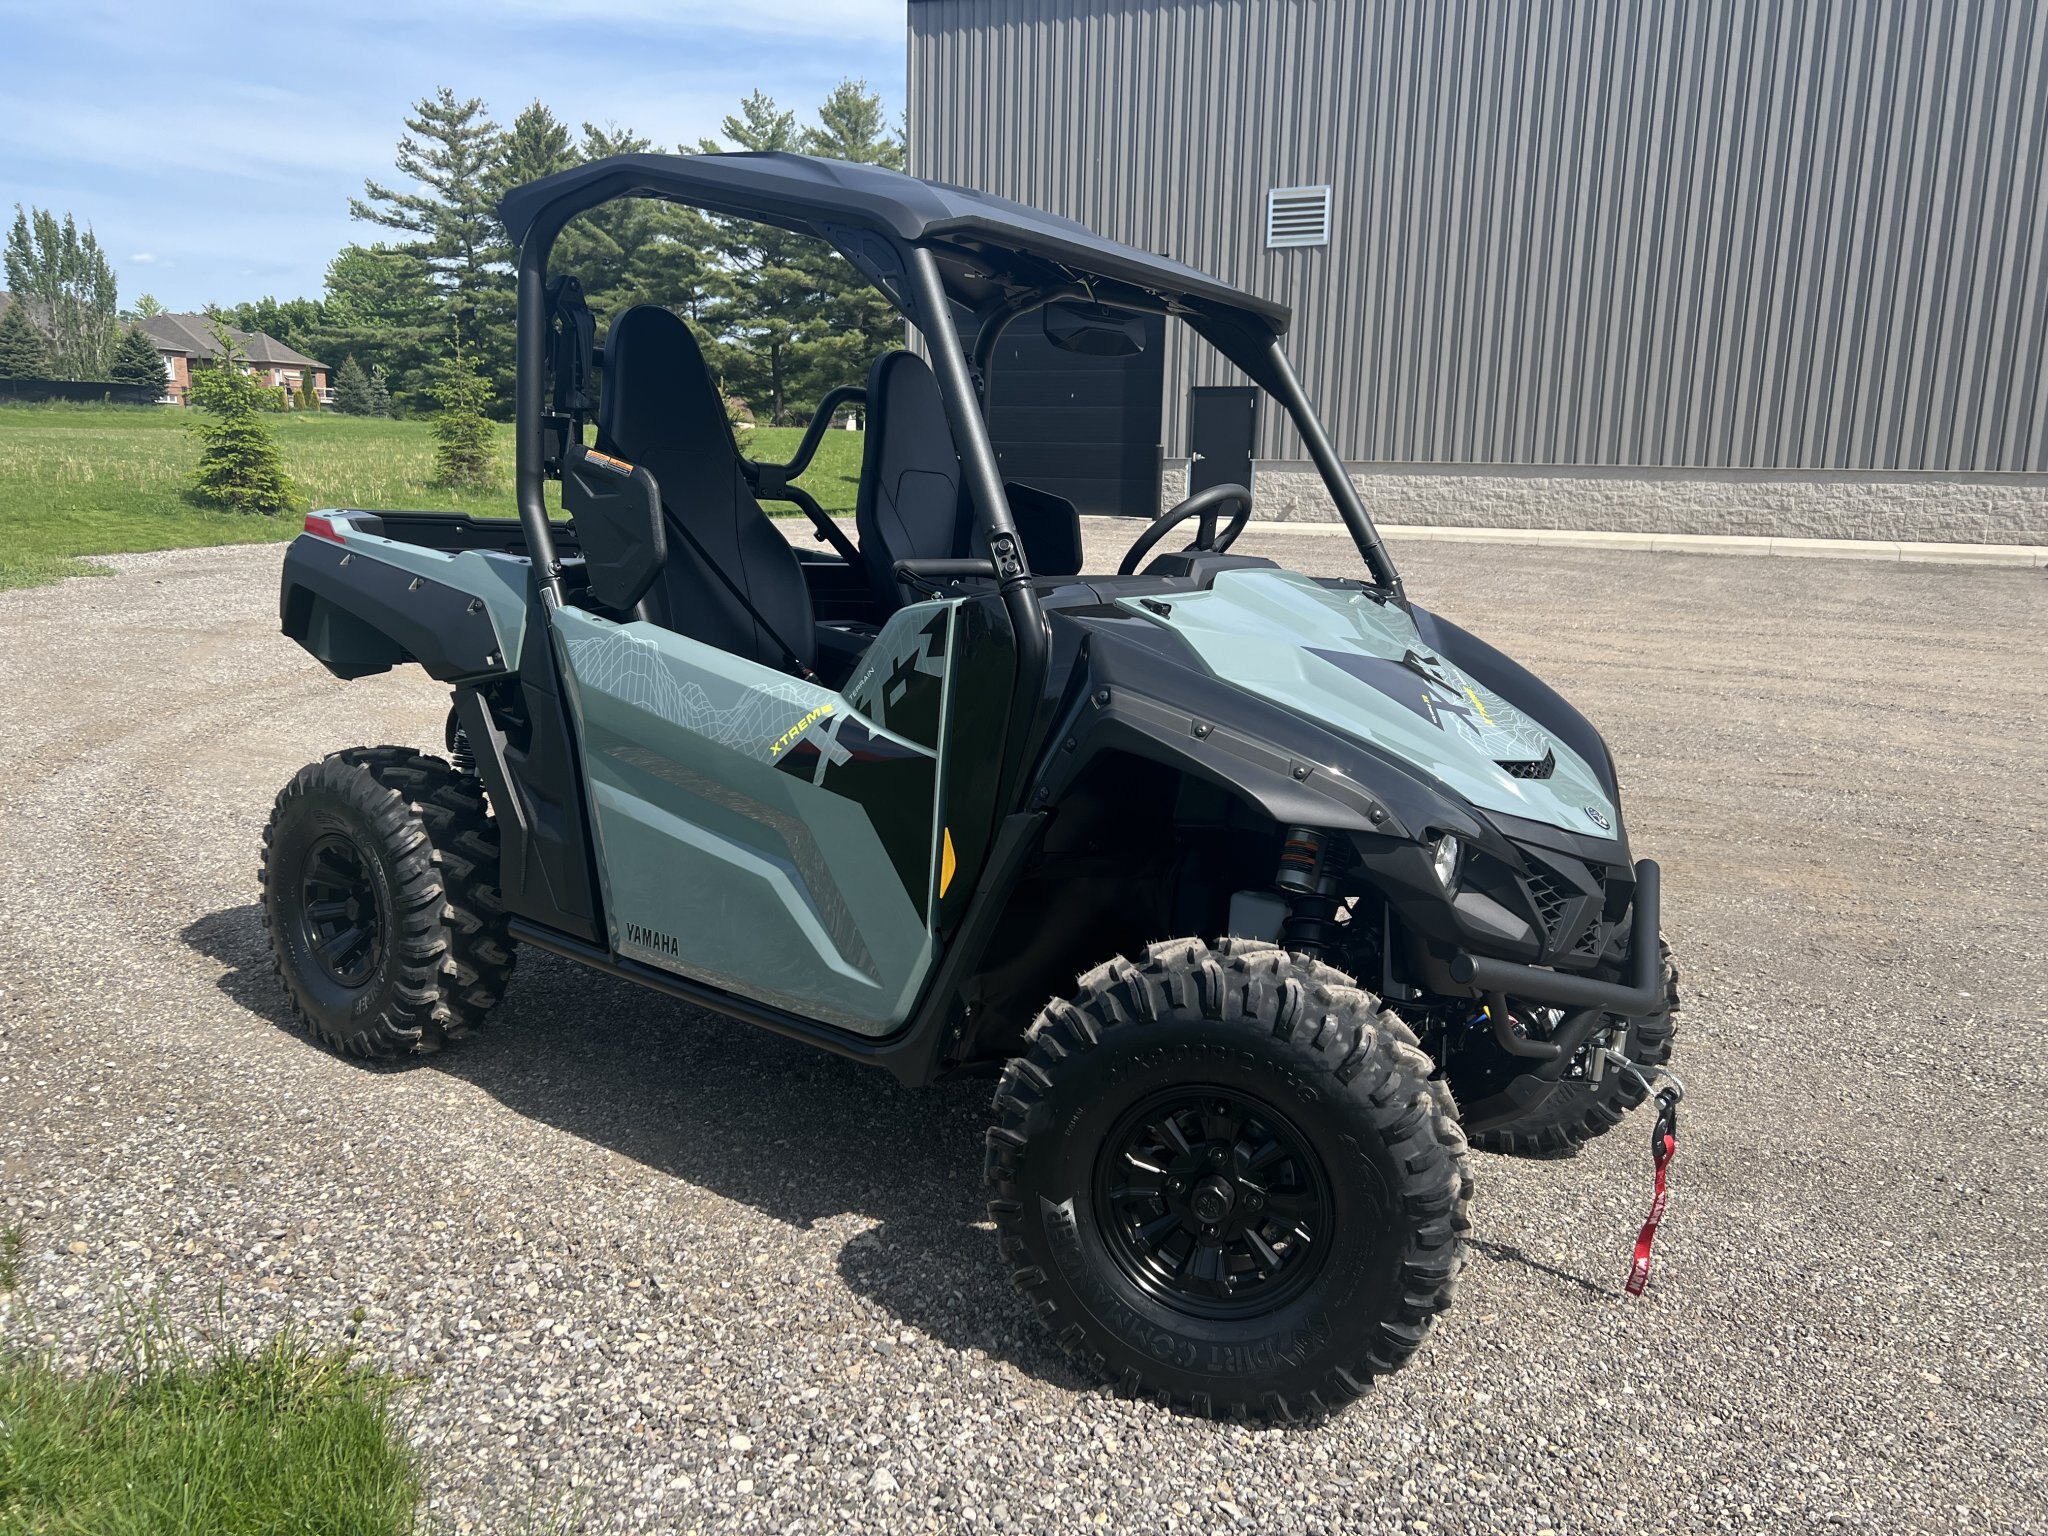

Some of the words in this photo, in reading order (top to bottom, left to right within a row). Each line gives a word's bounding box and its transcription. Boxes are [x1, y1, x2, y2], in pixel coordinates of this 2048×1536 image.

[849, 667, 875, 700] TERRAIN
[626, 922, 680, 957] YAMAHA
[1649, 1191, 1665, 1225] WARN
[1629, 1257, 1648, 1291] WARN
